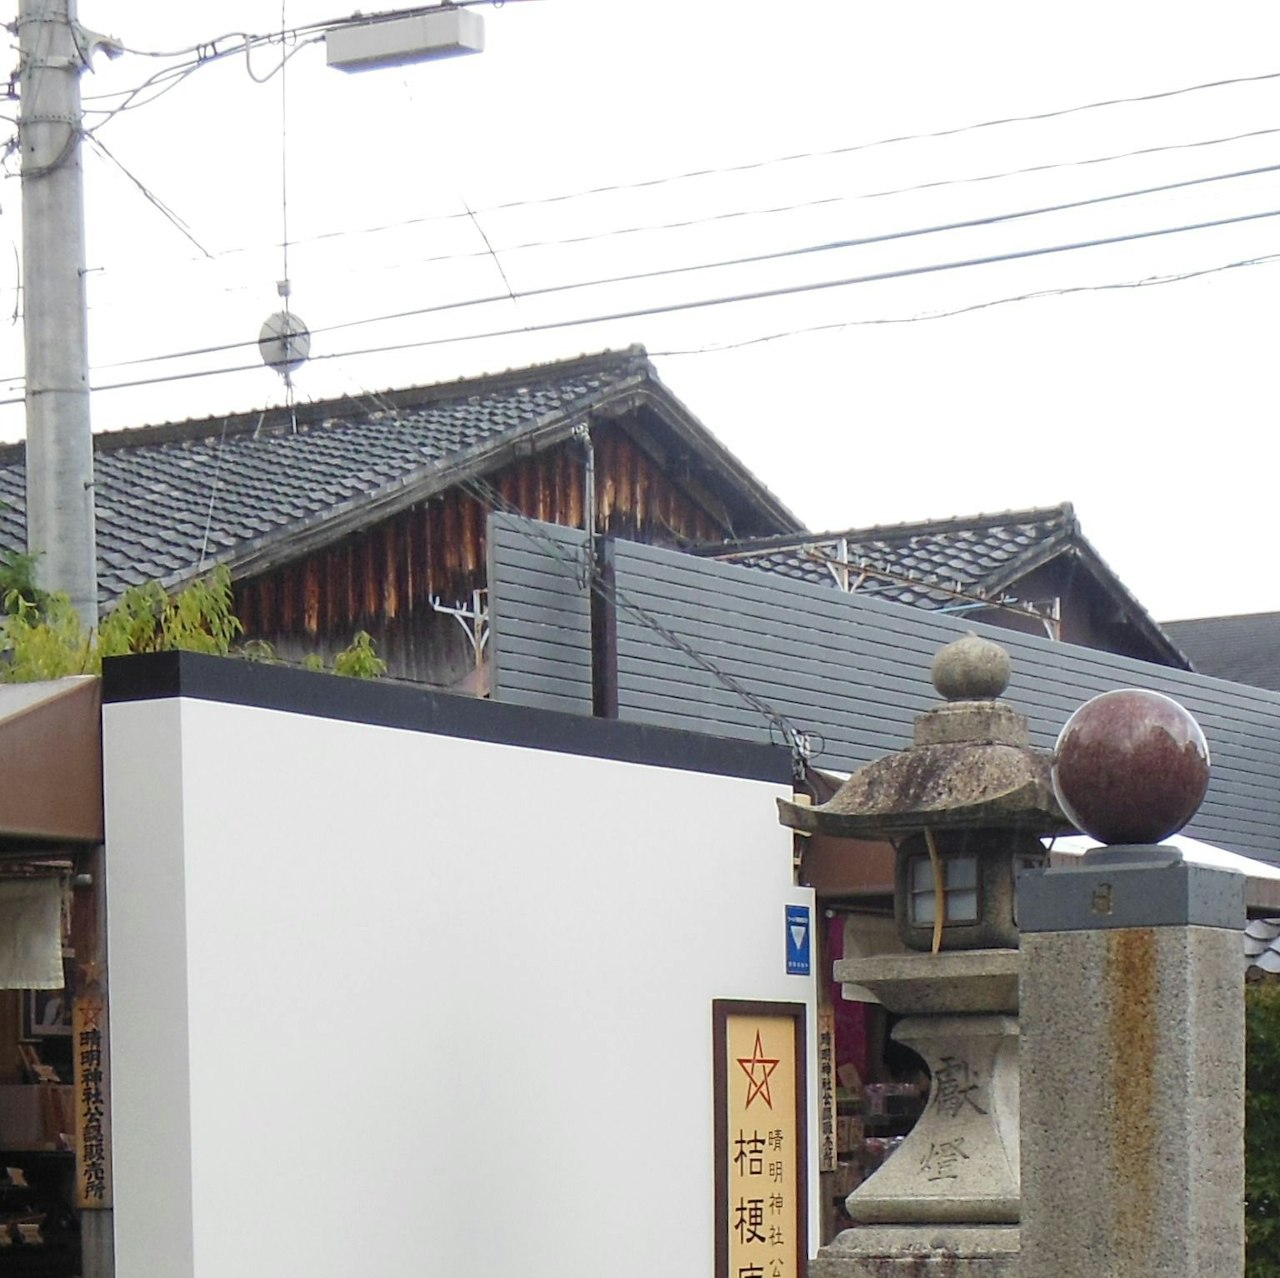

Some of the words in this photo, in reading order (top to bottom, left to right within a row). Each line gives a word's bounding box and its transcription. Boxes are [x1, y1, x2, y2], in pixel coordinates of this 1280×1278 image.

[79, 1028, 106, 1200] 晴明神社公認販売所
